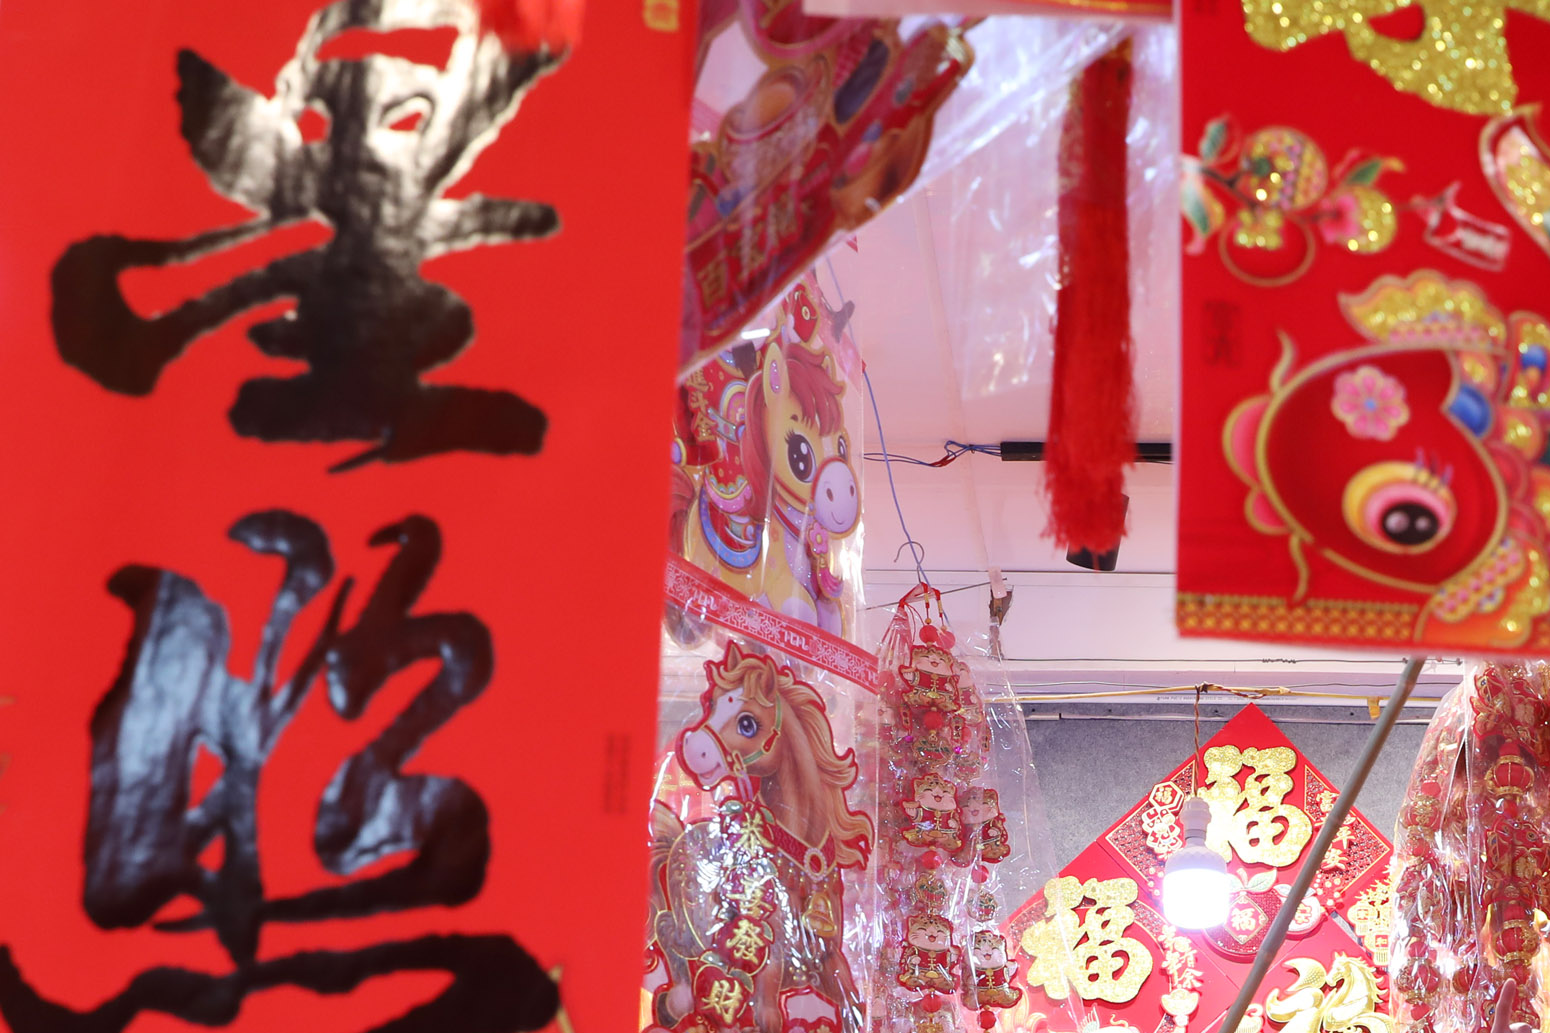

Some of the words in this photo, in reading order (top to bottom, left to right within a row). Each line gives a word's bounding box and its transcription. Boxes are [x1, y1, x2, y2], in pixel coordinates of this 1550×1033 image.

[1198, 745, 1313, 868] 福
[1021, 876, 1154, 1004] 福
[1230, 907, 1257, 932] 福
